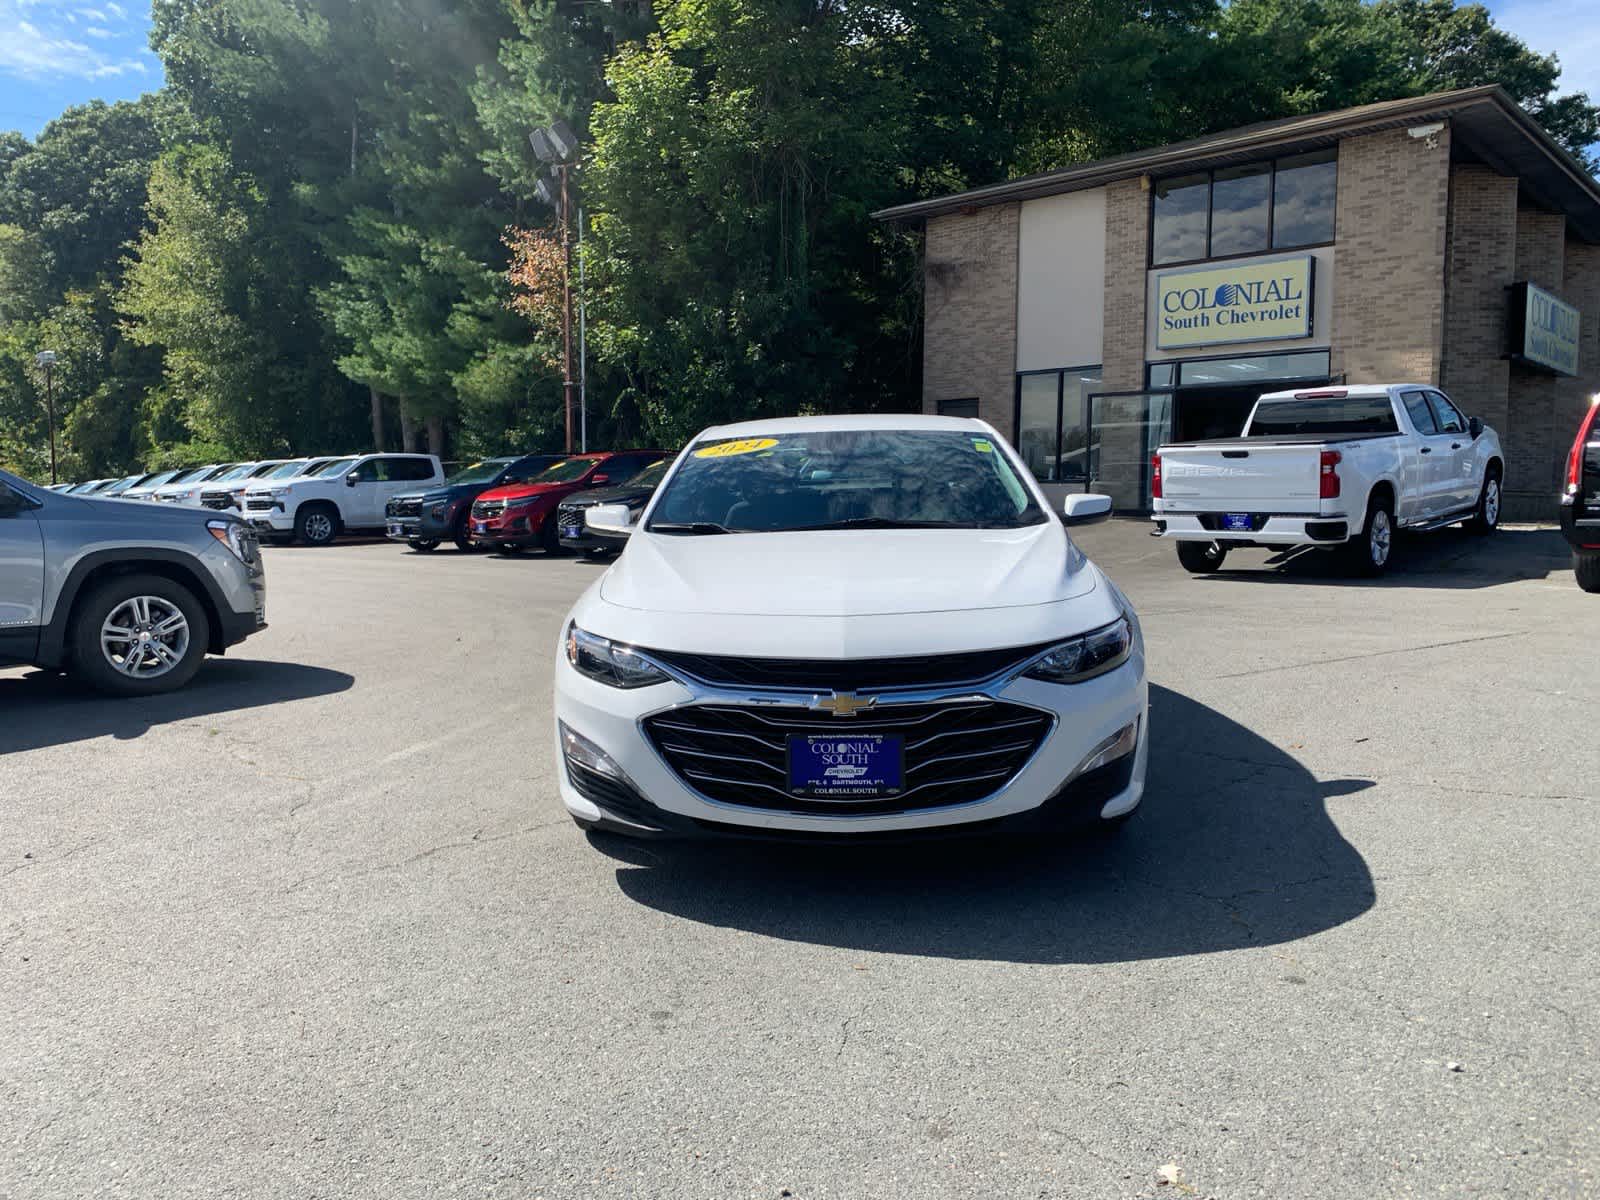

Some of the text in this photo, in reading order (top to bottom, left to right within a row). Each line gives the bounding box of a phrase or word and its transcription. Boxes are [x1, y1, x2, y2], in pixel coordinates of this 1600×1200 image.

[1163, 278, 1302, 313] COLONIAL
[1163, 304, 1302, 330] South Chevrolet
[811, 743, 880, 754] COLONIAL
[822, 754, 869, 765] SOUTH
[814, 787, 878, 795] COLONIAL SOUTH
